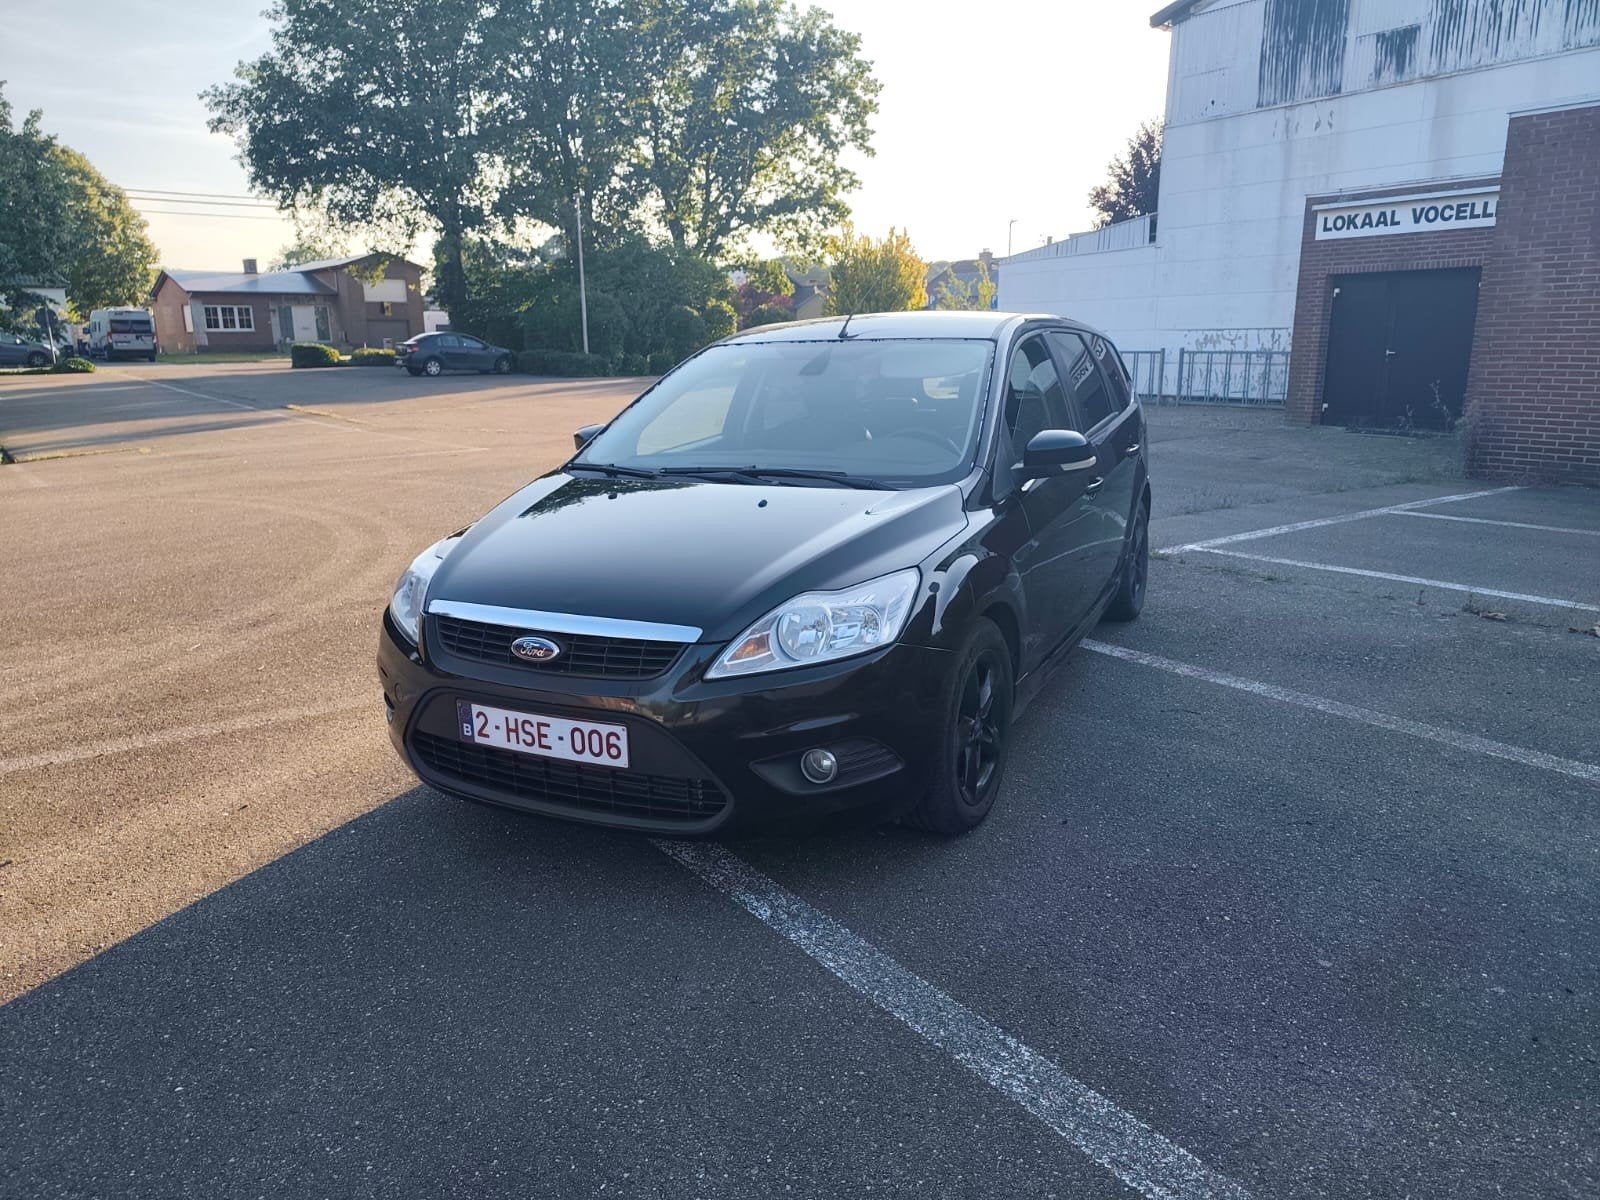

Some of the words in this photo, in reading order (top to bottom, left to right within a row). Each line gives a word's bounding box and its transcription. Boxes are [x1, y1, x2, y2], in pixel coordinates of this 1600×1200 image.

[1323, 210, 1400, 232] LOKAAL
[1412, 200, 1497, 224] VOCELL
[520, 641, 546, 657] Ford
[463, 723, 472, 736] B
[475, 711, 622, 760] 2-HSE-006
